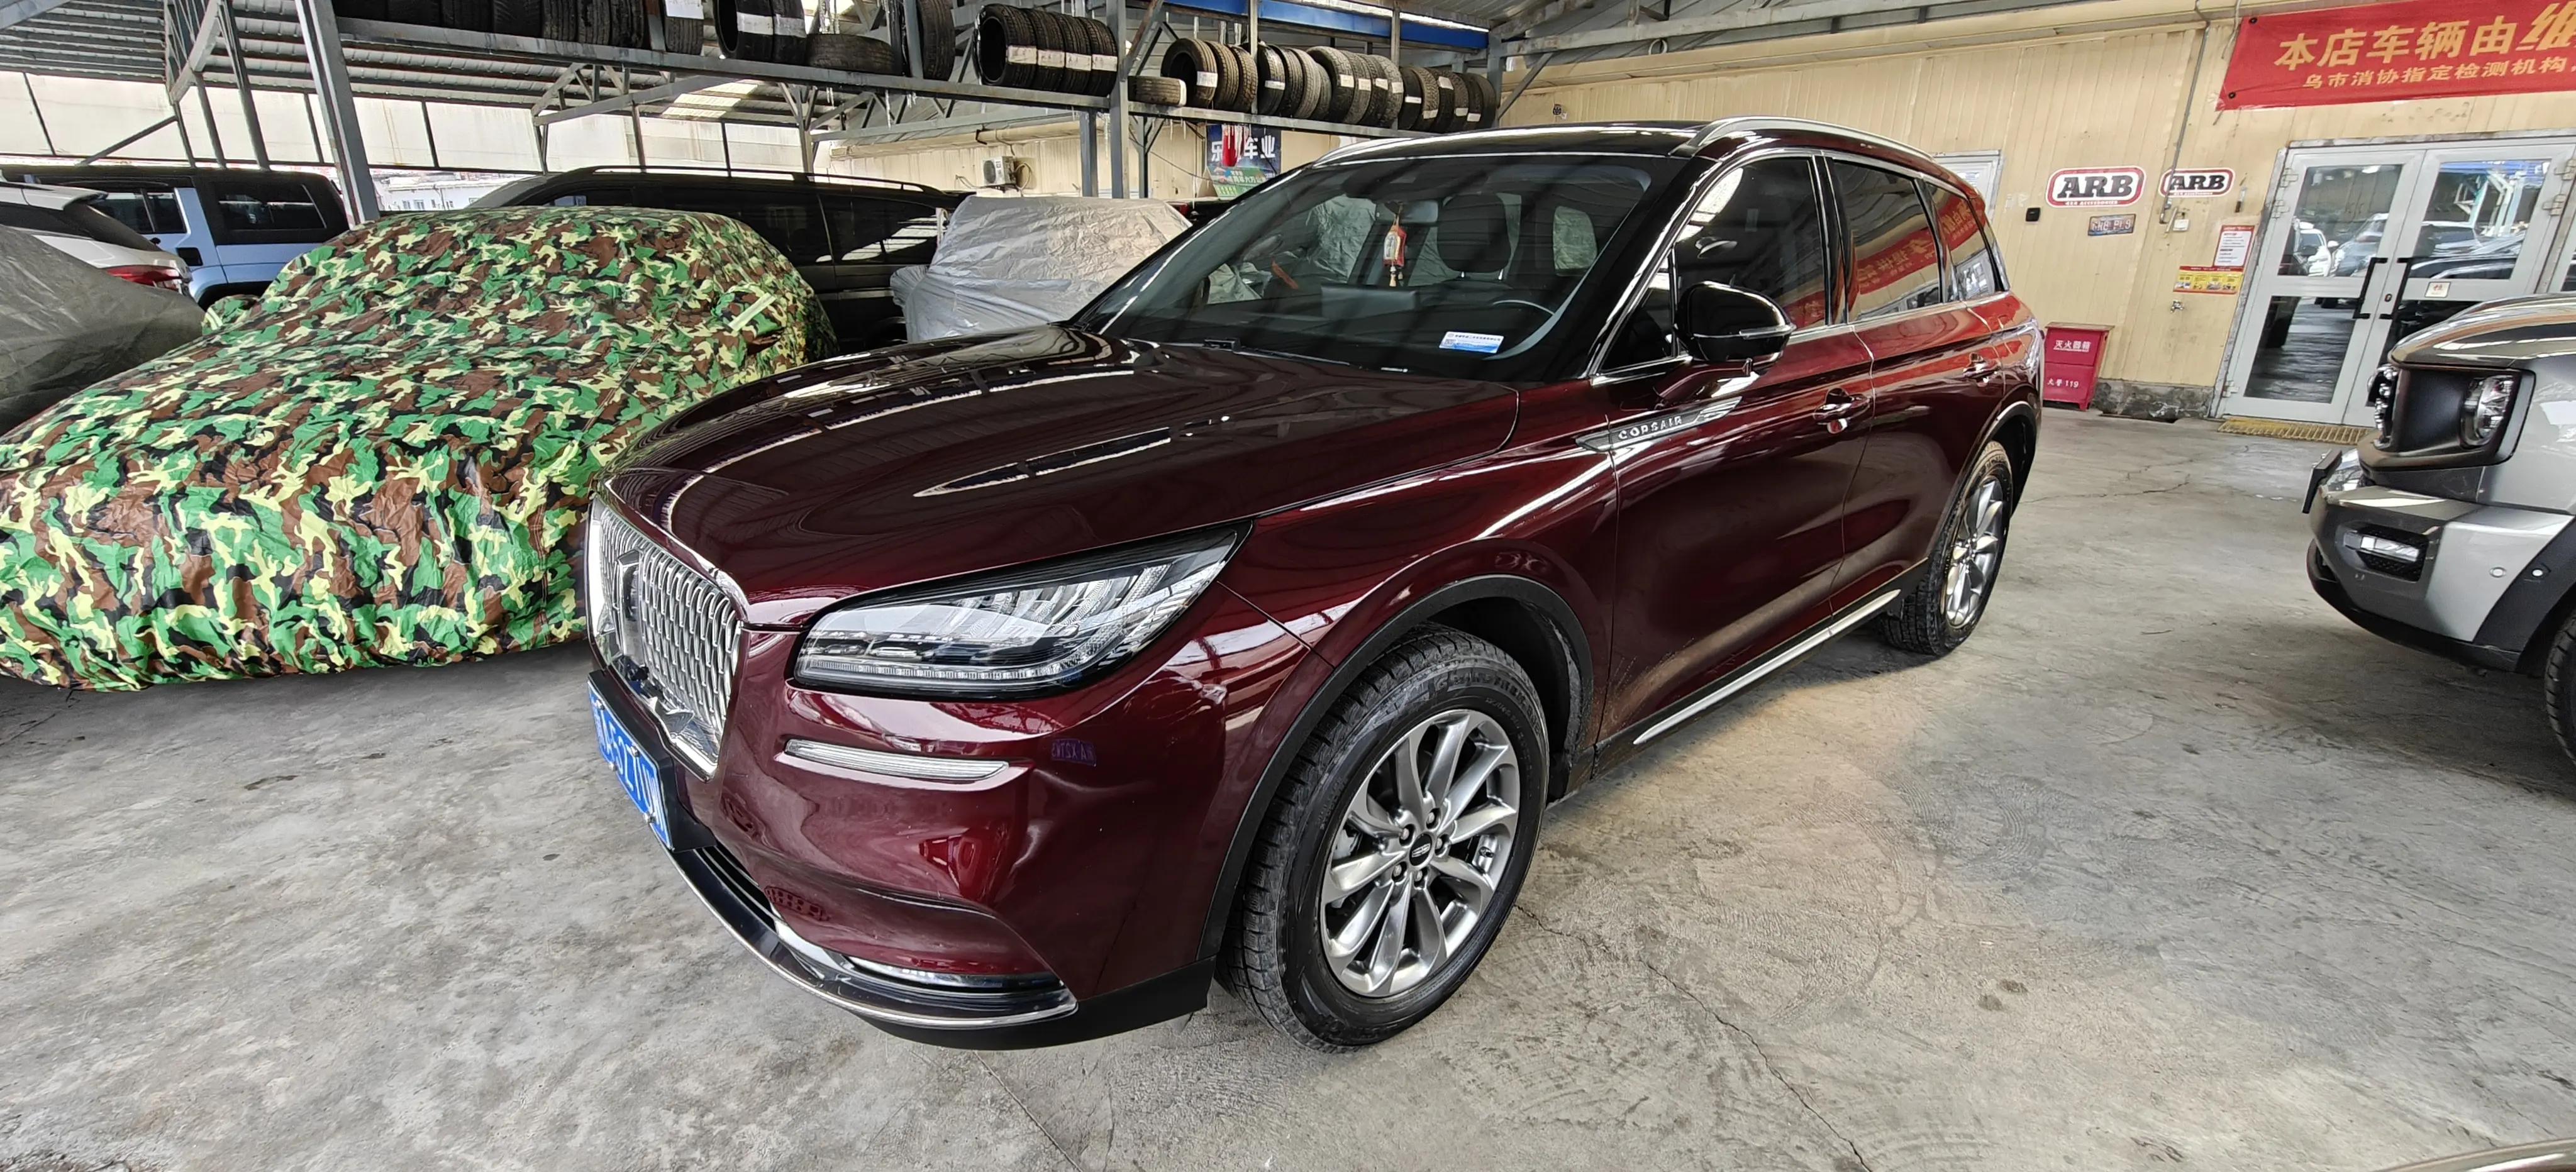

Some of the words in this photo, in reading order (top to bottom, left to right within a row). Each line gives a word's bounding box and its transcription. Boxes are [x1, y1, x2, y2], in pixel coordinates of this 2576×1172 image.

[1211, 135, 1275, 162] 乐车业
[2057, 175, 2133, 199] ARB
[2169, 175, 2225, 191] ARB
[2065, 380, 2079, 388] 119
[1618, 416, 1682, 440] CORSAIR
